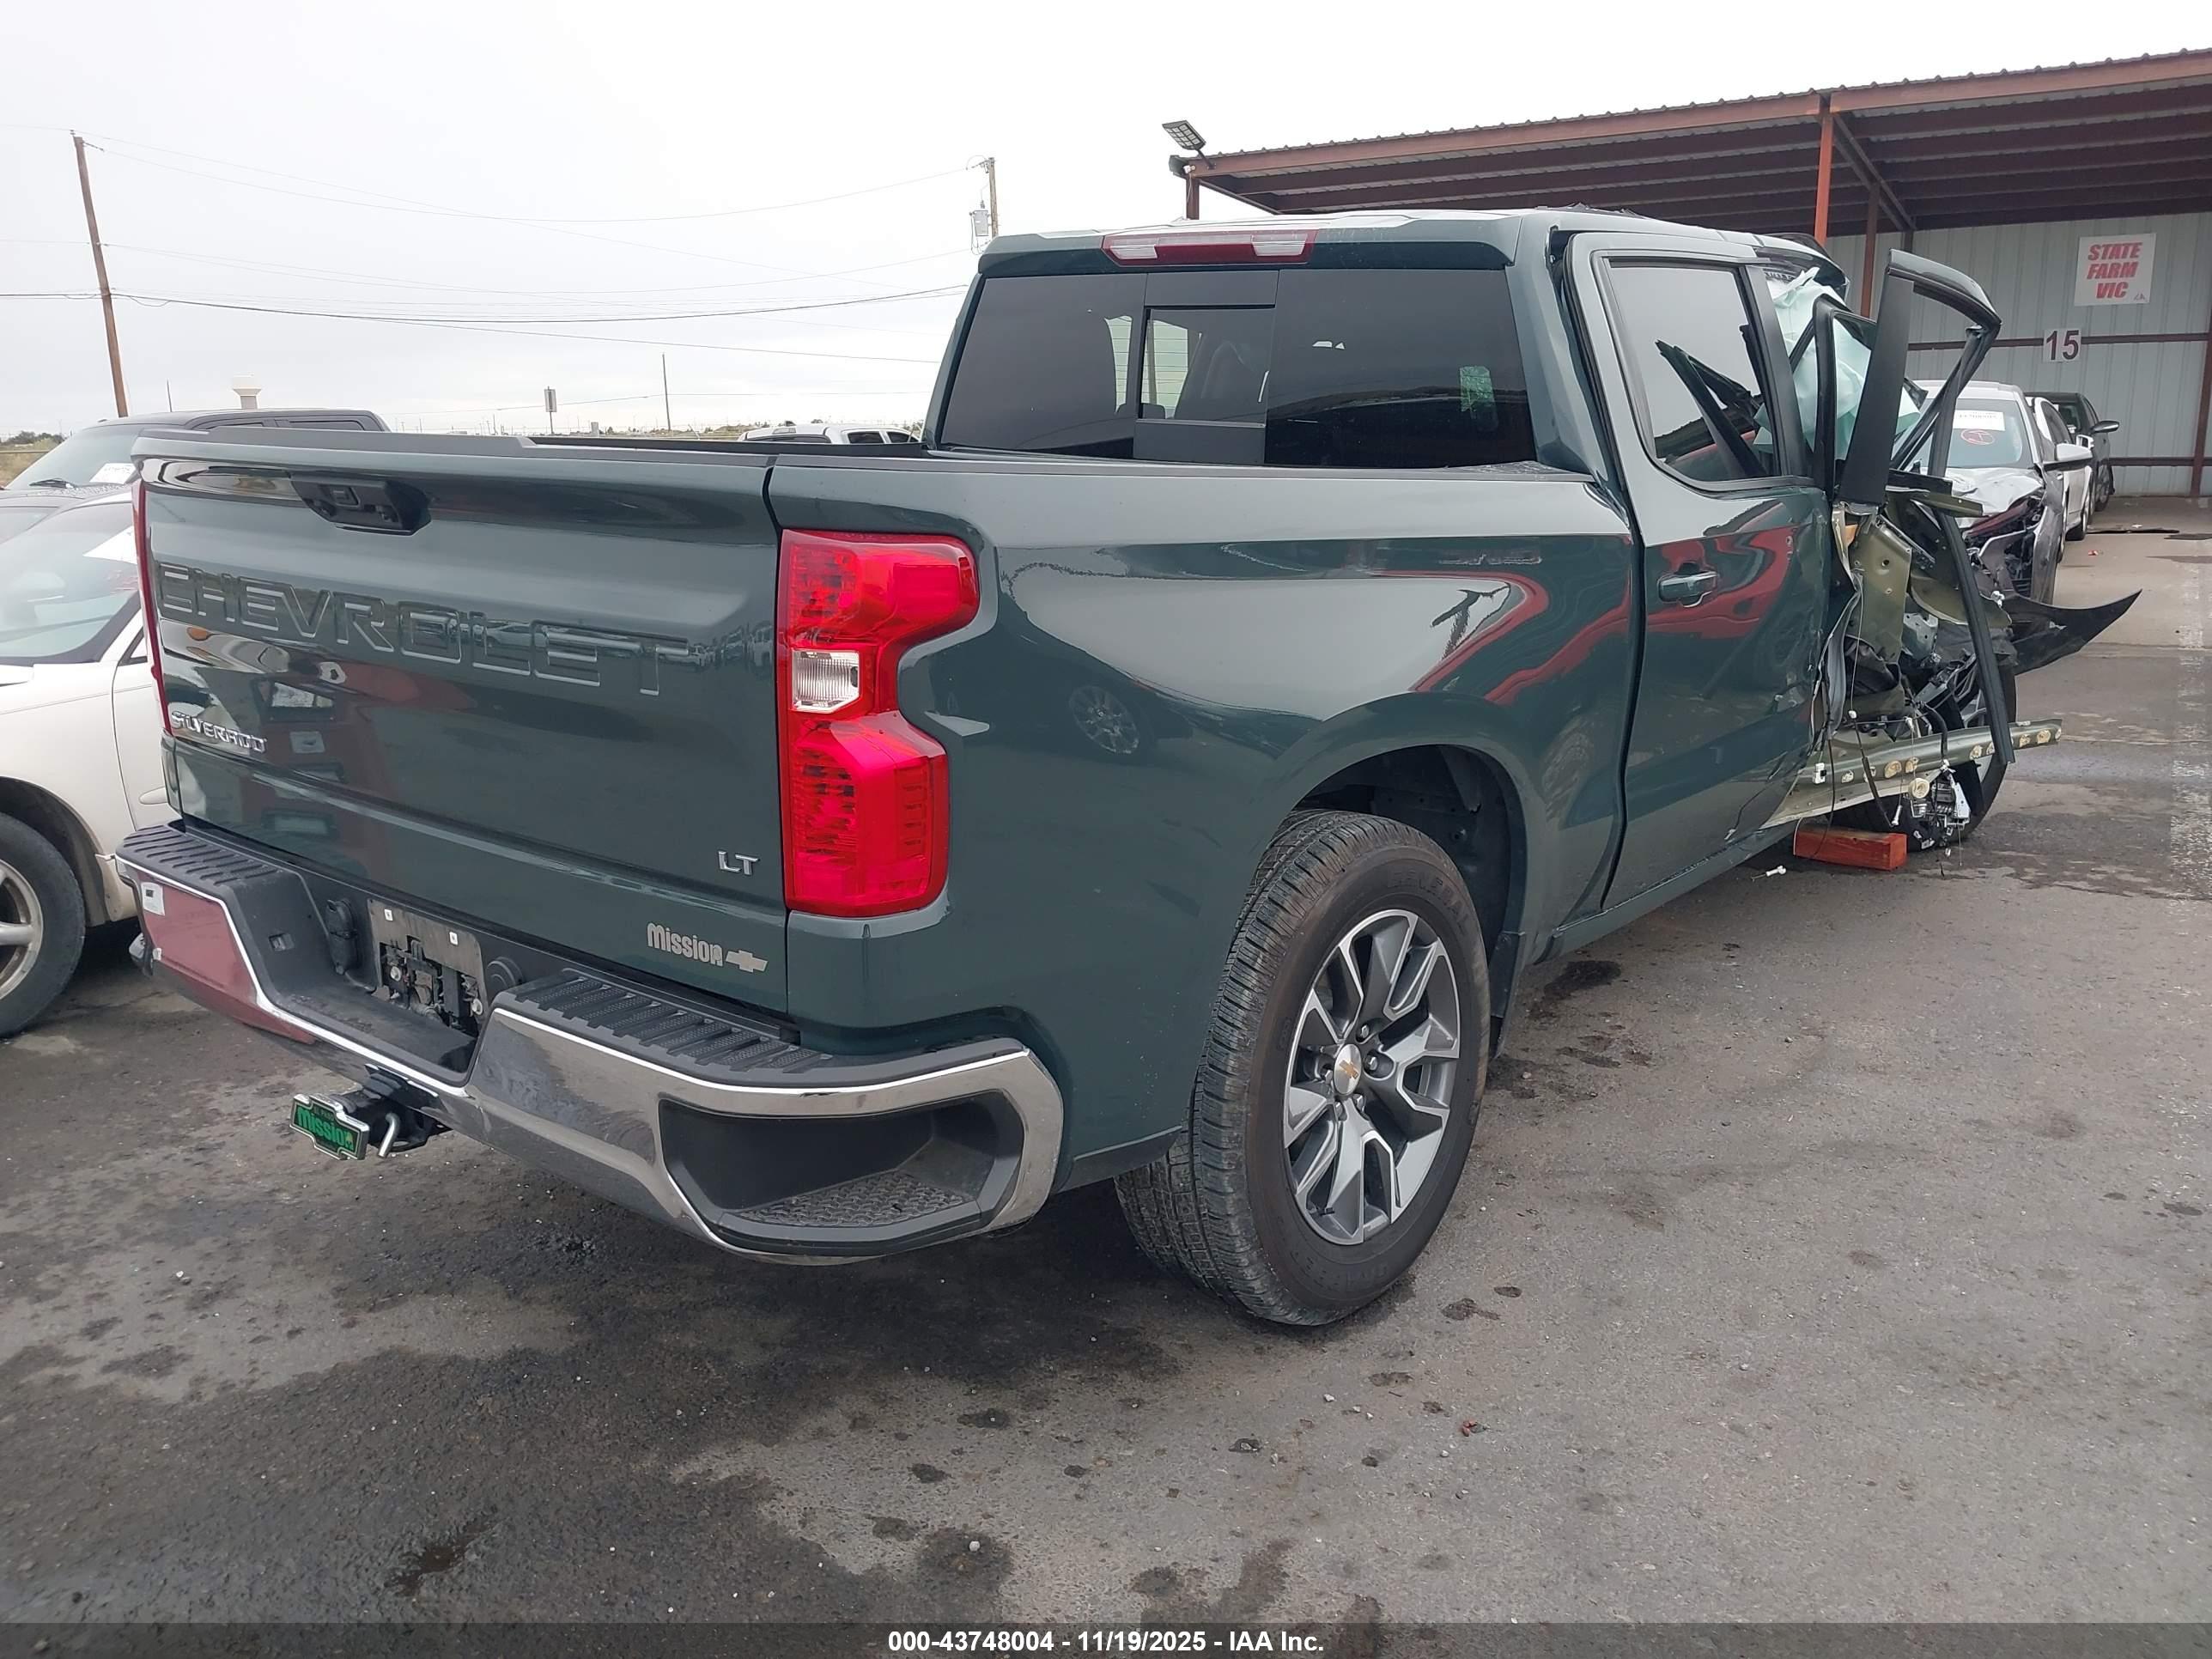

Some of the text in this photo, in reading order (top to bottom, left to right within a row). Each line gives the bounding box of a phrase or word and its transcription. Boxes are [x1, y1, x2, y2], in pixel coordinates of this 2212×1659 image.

[2087, 242, 2143, 261] STATE
[2087, 261, 2139, 280] FARM
[2095, 281, 2129, 299] VIC
[2045, 330, 2080, 361] 15
[159, 561, 690, 696] CHEVROLET
[171, 710, 267, 754] SILVERADO
[718, 850, 760, 876] LT
[647, 921, 724, 968] Mission
[296, 1105, 355, 1152] Mission
